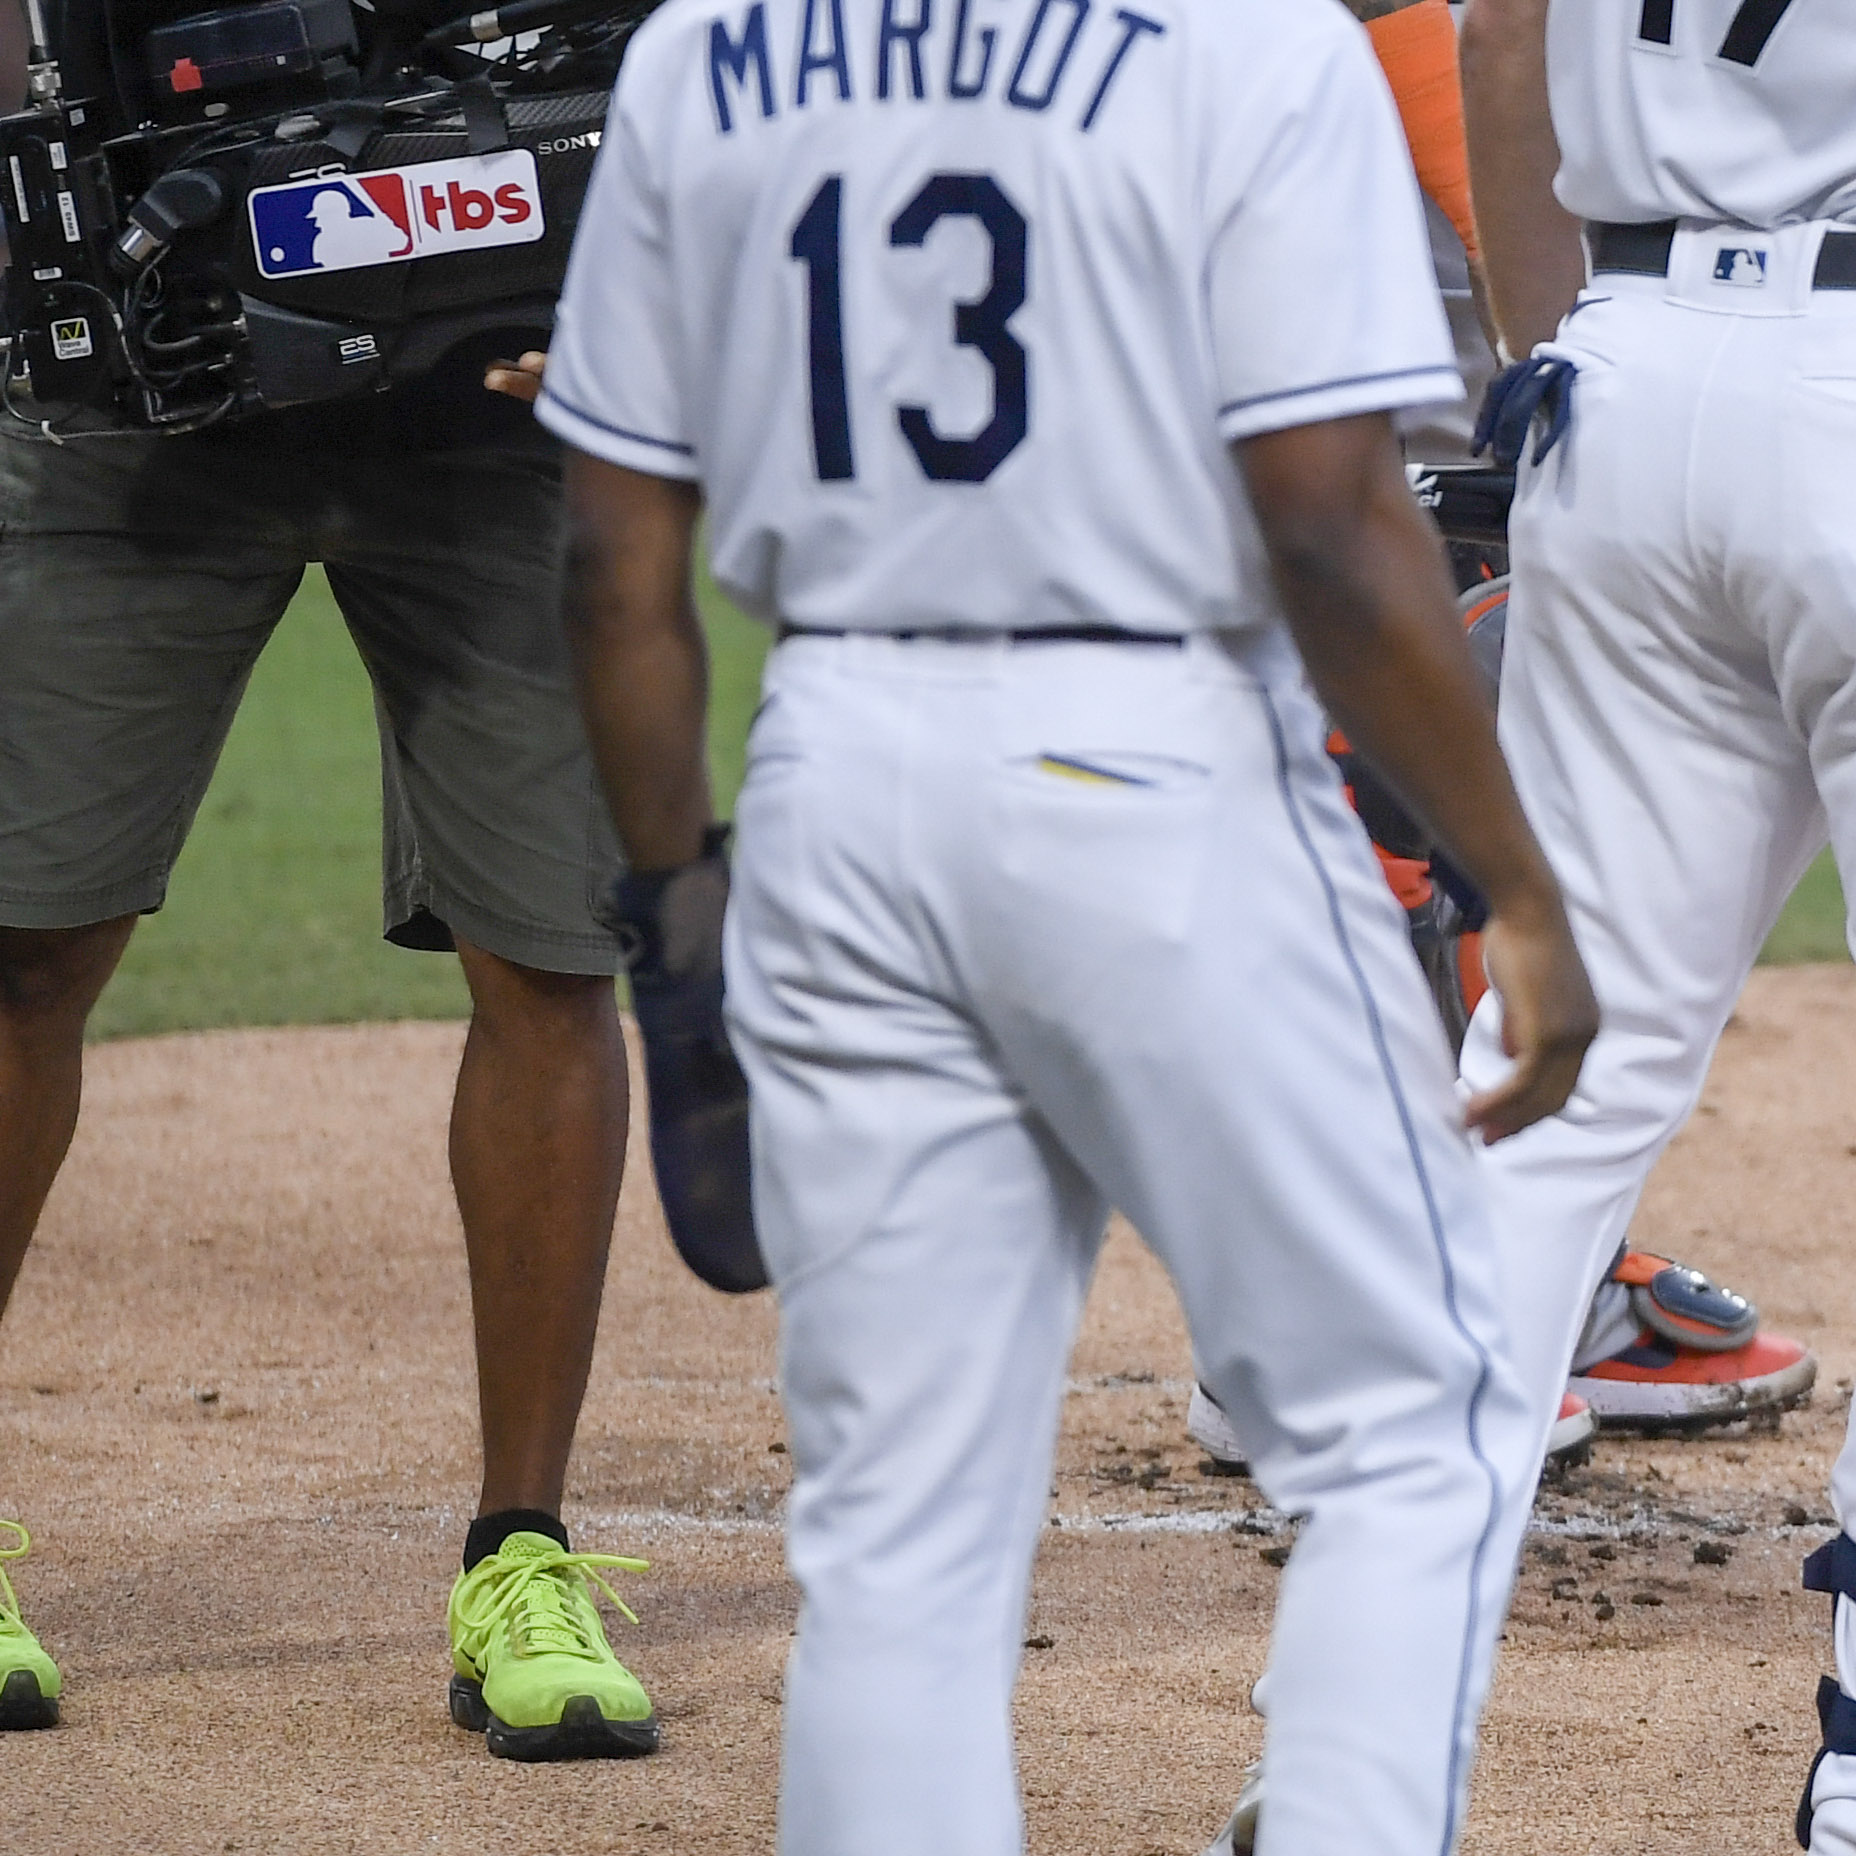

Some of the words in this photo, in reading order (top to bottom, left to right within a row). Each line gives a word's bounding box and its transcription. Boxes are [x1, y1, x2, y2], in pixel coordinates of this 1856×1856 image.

[538, 131, 602, 155] SONY
[420, 181, 531, 233] tbs
[791, 172, 1028, 485] 13
